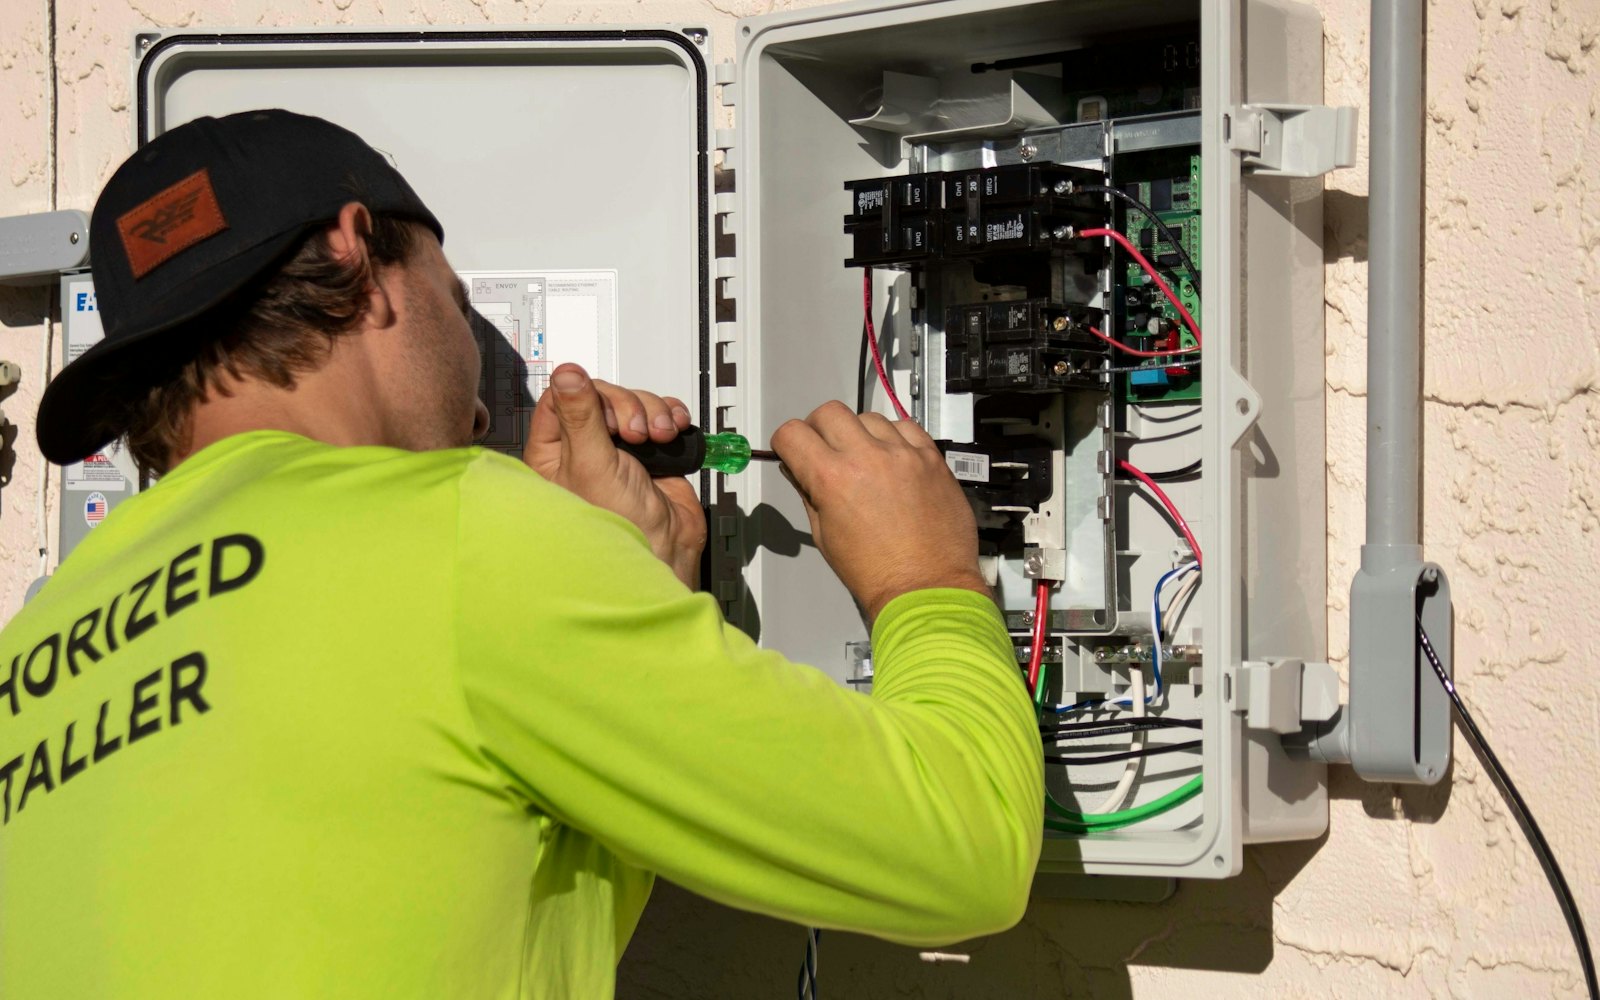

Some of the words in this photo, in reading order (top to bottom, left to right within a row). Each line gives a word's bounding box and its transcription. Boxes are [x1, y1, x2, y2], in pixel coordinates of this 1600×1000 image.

[970, 181, 977, 191] 20
[970, 226, 977, 237] 20
[971, 315, 979, 326] 15
[972, 360, 979, 370] 15
